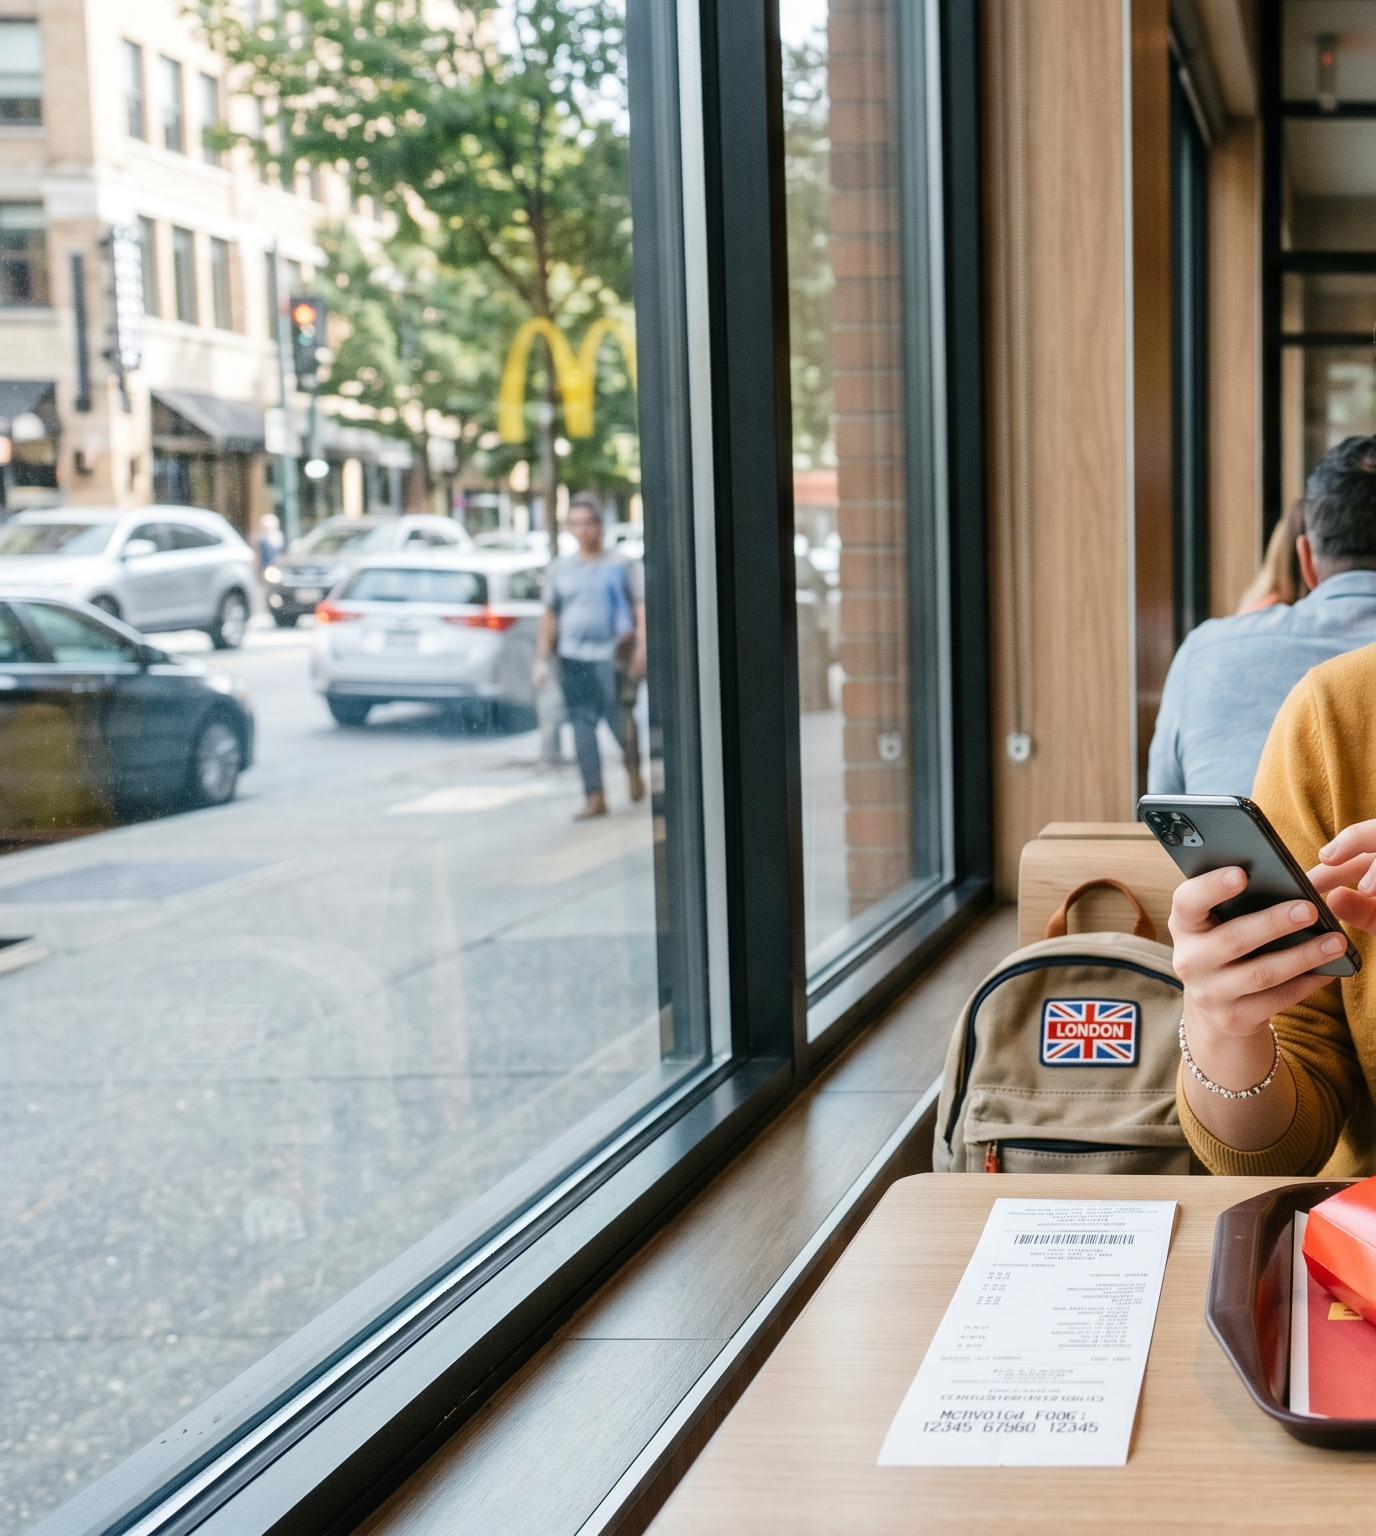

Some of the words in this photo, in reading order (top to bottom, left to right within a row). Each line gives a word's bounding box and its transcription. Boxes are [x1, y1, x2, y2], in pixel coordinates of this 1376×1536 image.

[1056, 1023, 1124, 1038] LONDON
[922, 1421, 973, 1433] 12345
[1049, 1421, 1099, 1433] 12345
